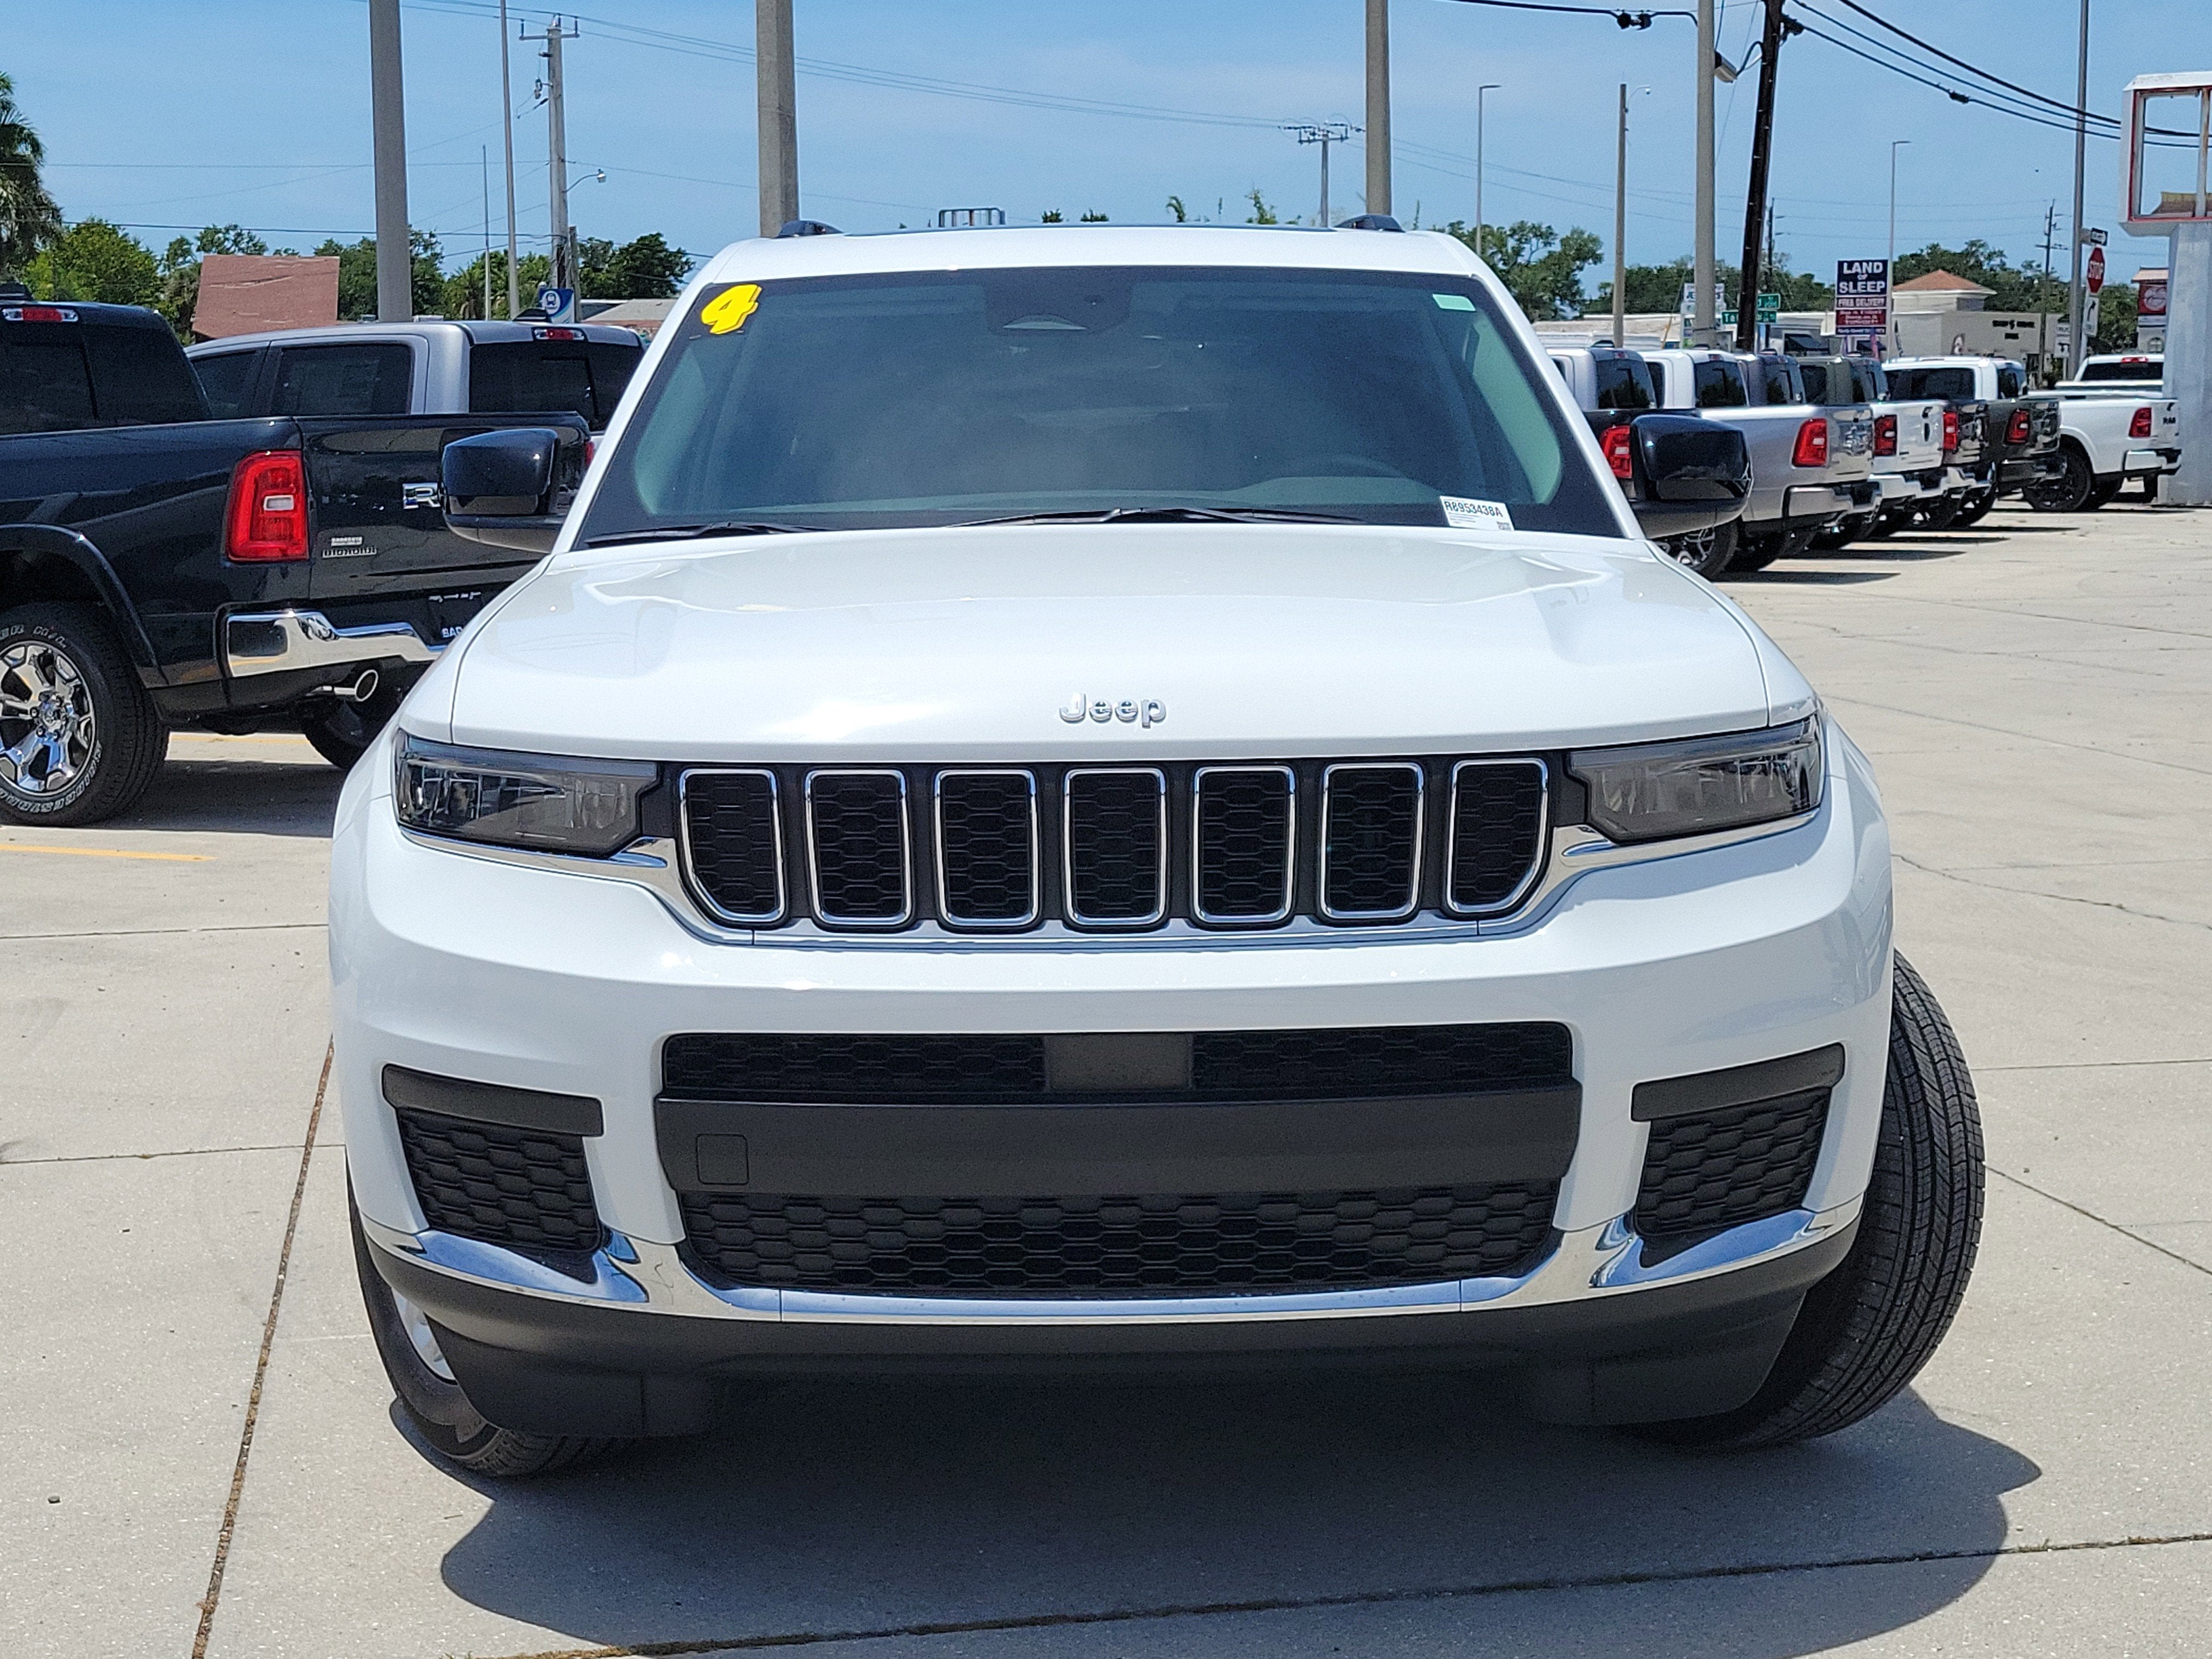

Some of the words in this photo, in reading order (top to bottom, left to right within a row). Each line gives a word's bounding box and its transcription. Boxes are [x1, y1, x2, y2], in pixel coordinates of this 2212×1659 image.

[1843, 262, 1883, 274] LAND
[2087, 260, 2103, 280] STOP
[1839, 280, 1886, 294] SLEEP
[701, 284, 762, 335] 4
[402, 482, 441, 509] R
[1059, 693, 1166, 729] Jeep
